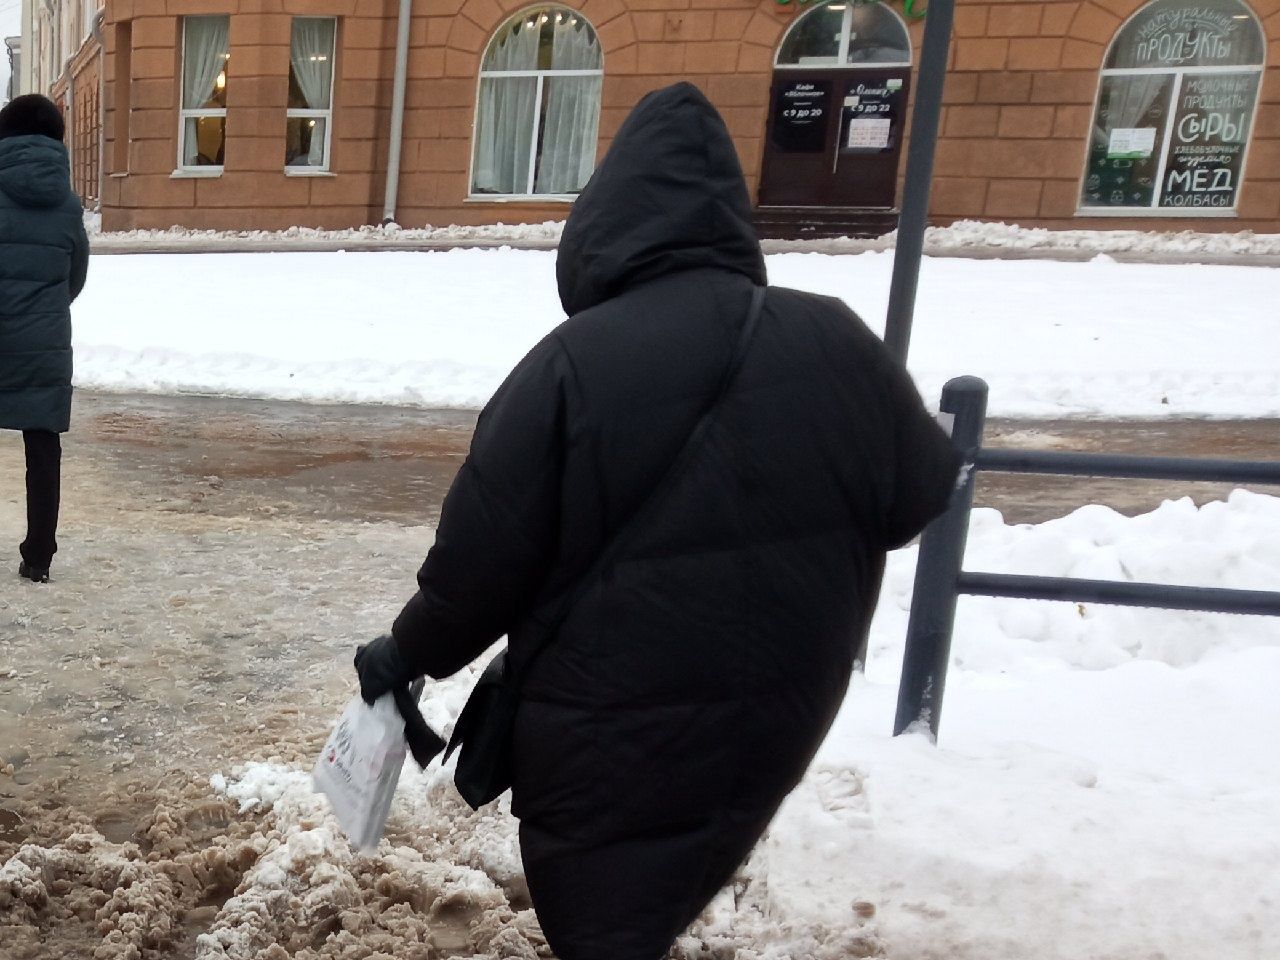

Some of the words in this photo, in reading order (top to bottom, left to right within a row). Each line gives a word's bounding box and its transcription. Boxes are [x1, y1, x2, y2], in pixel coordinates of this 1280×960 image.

[1136, 31, 1232, 63] ПРОДУКТЫ
[1183, 95, 1247, 109] ПРОДУКТЫ
[1166, 165, 1233, 192] МЁД
[1163, 194, 1230, 207] КОЛБАСЫ
